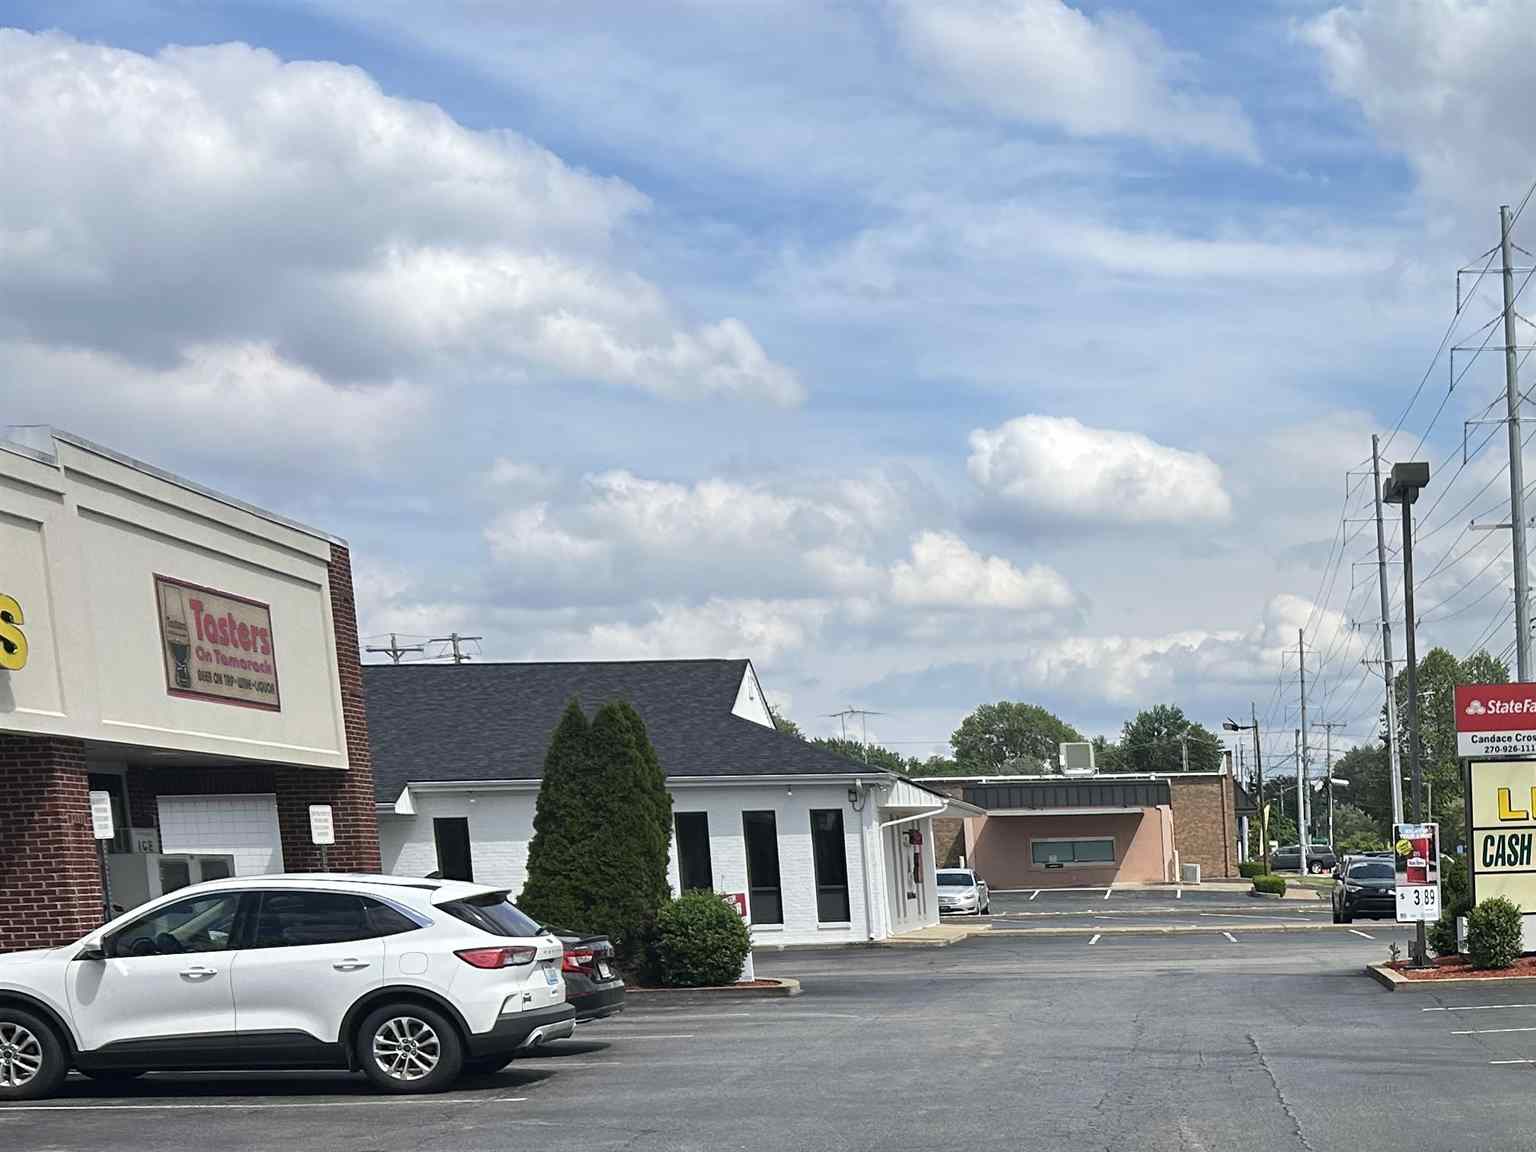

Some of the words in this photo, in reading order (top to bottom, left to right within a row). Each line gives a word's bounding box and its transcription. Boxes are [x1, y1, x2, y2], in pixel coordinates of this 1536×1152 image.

[189, 599, 272, 656] Tasters
[195, 645, 212, 663] On
[1471, 733, 1513, 745] Candace
[1482, 833, 1532, 867] CASH
